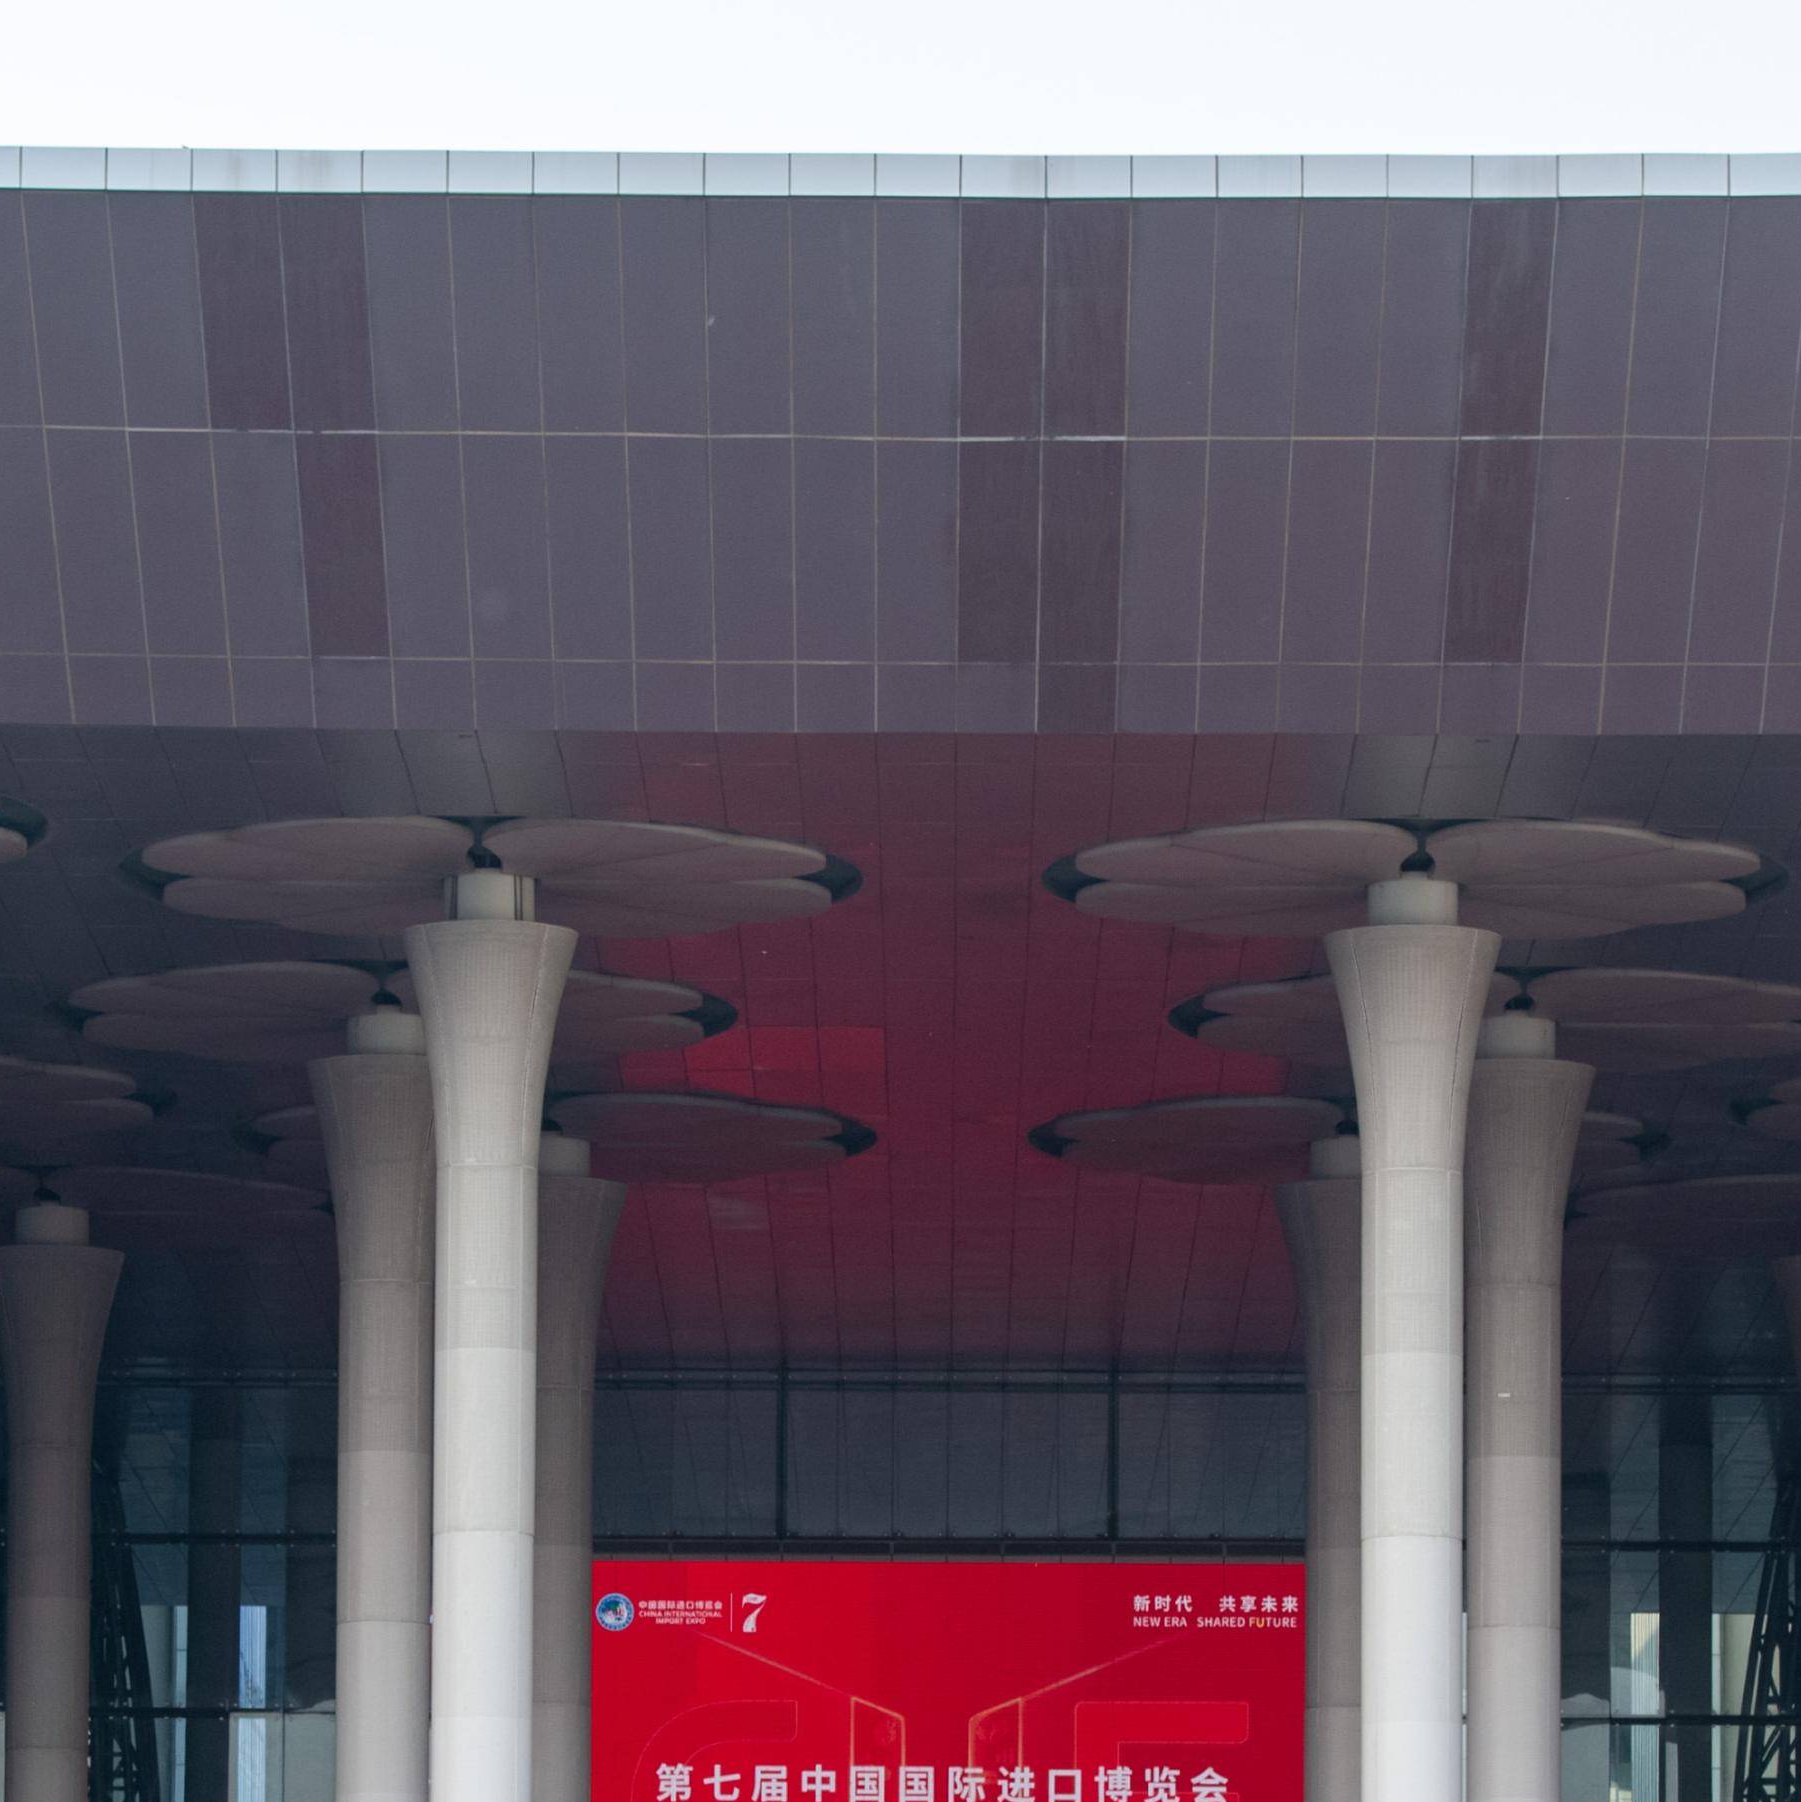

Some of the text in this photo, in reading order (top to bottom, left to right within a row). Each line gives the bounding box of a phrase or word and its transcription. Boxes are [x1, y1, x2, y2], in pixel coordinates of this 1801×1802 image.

[742, 1593, 767, 1632] 7
[1133, 1595, 1298, 1613] 新时代 共享未来
[1133, 1617, 1297, 1628] NEW ERA SHARED FUTURE
